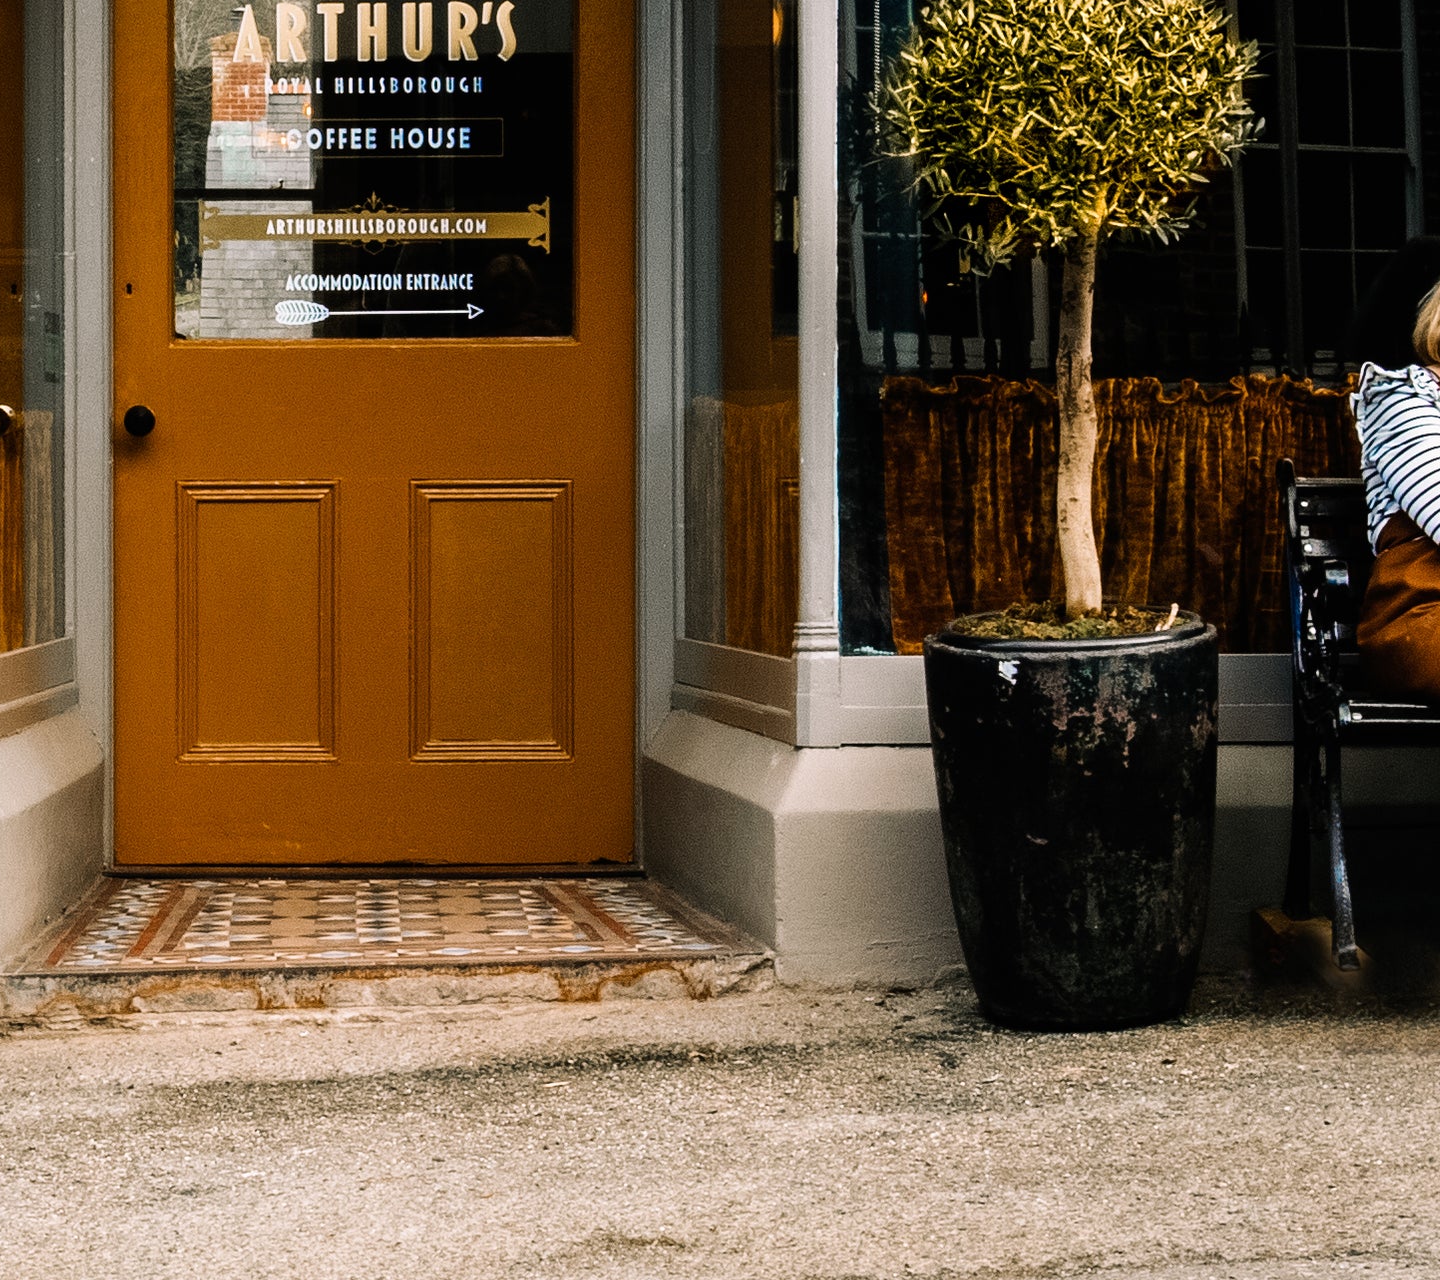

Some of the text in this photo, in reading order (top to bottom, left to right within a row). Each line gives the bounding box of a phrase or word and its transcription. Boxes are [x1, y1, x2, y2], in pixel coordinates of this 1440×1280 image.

[232, 0, 518, 63] ARTHUR'S
[266, 75, 484, 95] ROYAL HILLSBOROUGH
[287, 126, 472, 151] COFFEE HOUSE
[265, 217, 488, 236] ARTHURSHILLSBOROUGH.COM
[285, 272, 475, 293] ACCOMMODATION ENTRANCE
